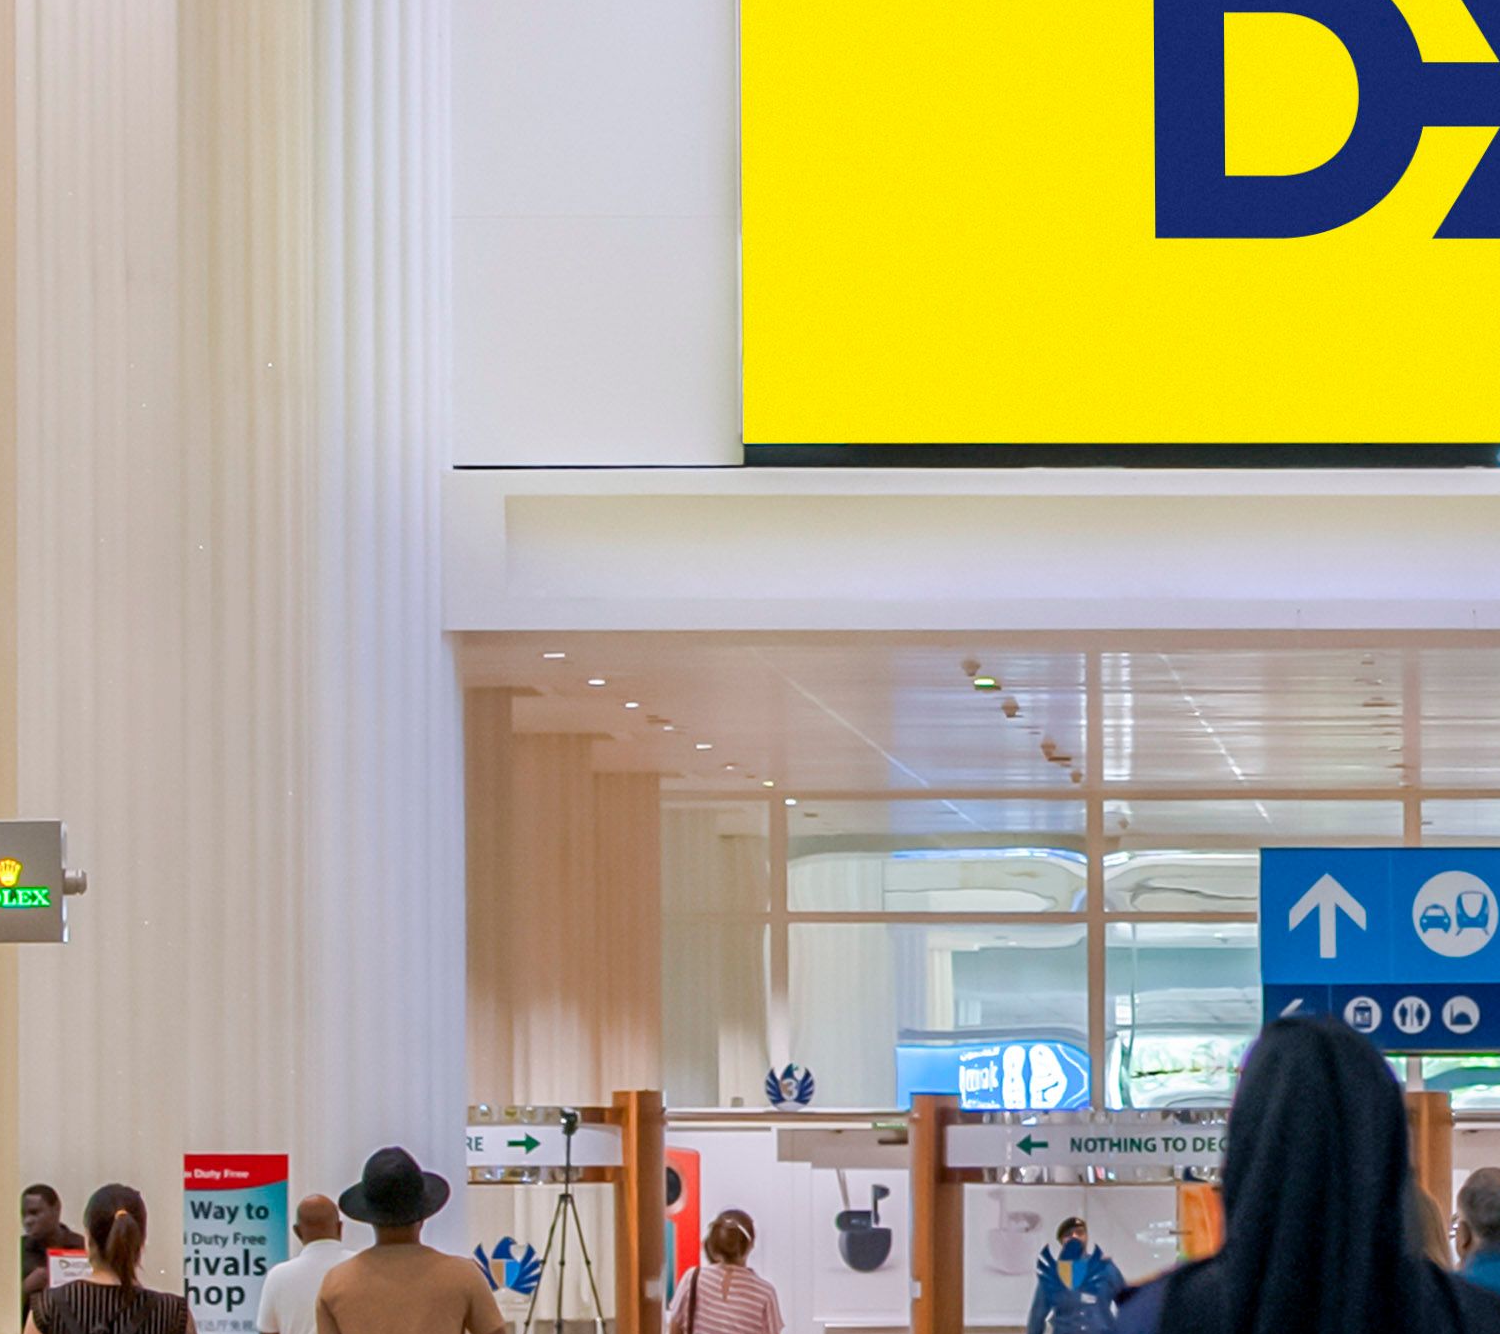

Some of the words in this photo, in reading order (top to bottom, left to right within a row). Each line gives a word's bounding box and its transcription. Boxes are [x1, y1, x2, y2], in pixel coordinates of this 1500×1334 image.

[1069, 1136, 1157, 1153] NOTHING
[1162, 1136, 1187, 1153] TO
[193, 1168, 222, 1180] Duty
[190, 1200, 240, 1224] Way
[245, 1202, 270, 1220] to
[191, 1232, 229, 1249] Duty
[232, 1232, 267, 1246] Free
